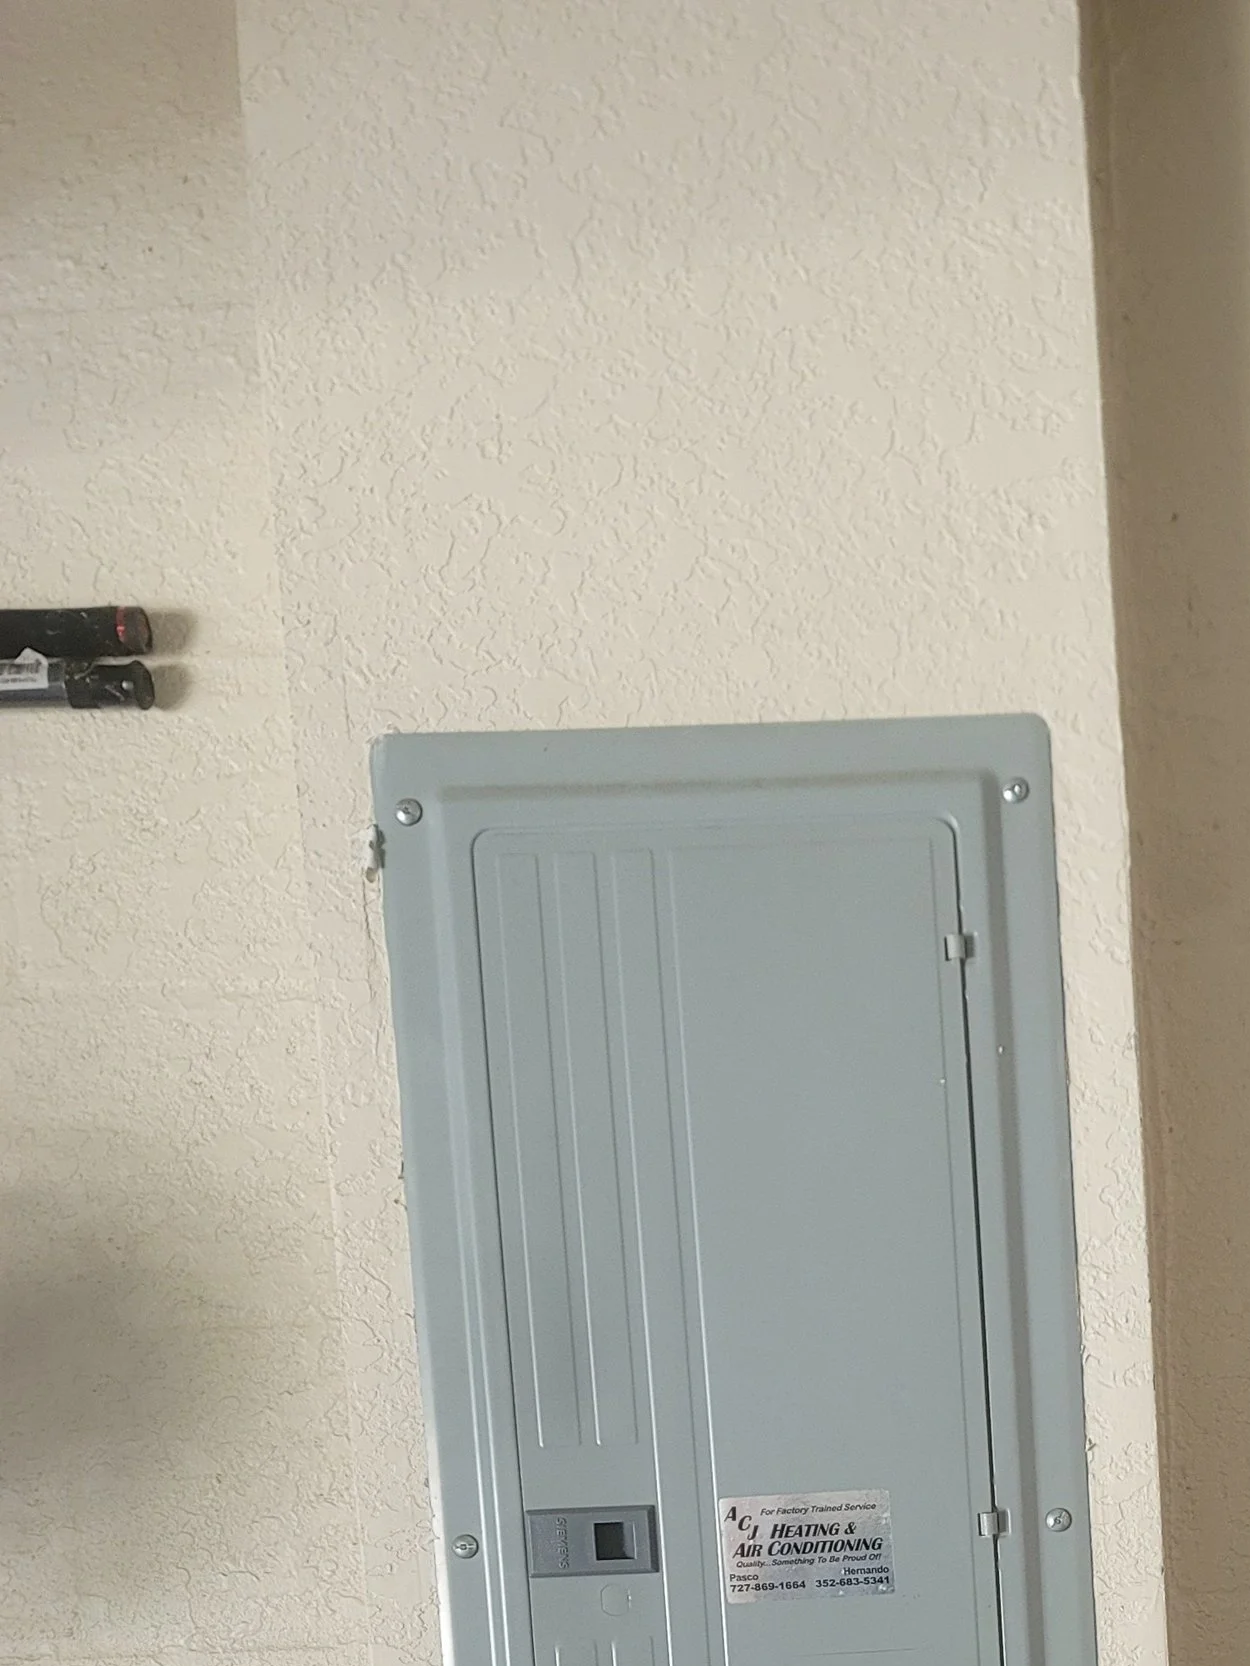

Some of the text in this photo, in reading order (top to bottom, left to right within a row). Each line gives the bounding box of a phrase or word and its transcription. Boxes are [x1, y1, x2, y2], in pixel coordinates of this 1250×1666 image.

[760, 1502, 877, 1516] For Factory Trained Service
[770, 1521, 857, 1539] HEATING &
[732, 1537, 883, 1559] AIR CONDITIONING
[842, 1554, 867, 1562] Proud
[729, 1566, 889, 1582] Pasco Hernando
[730, 1576, 890, 1592] 727-869-1664 352-683-5341
